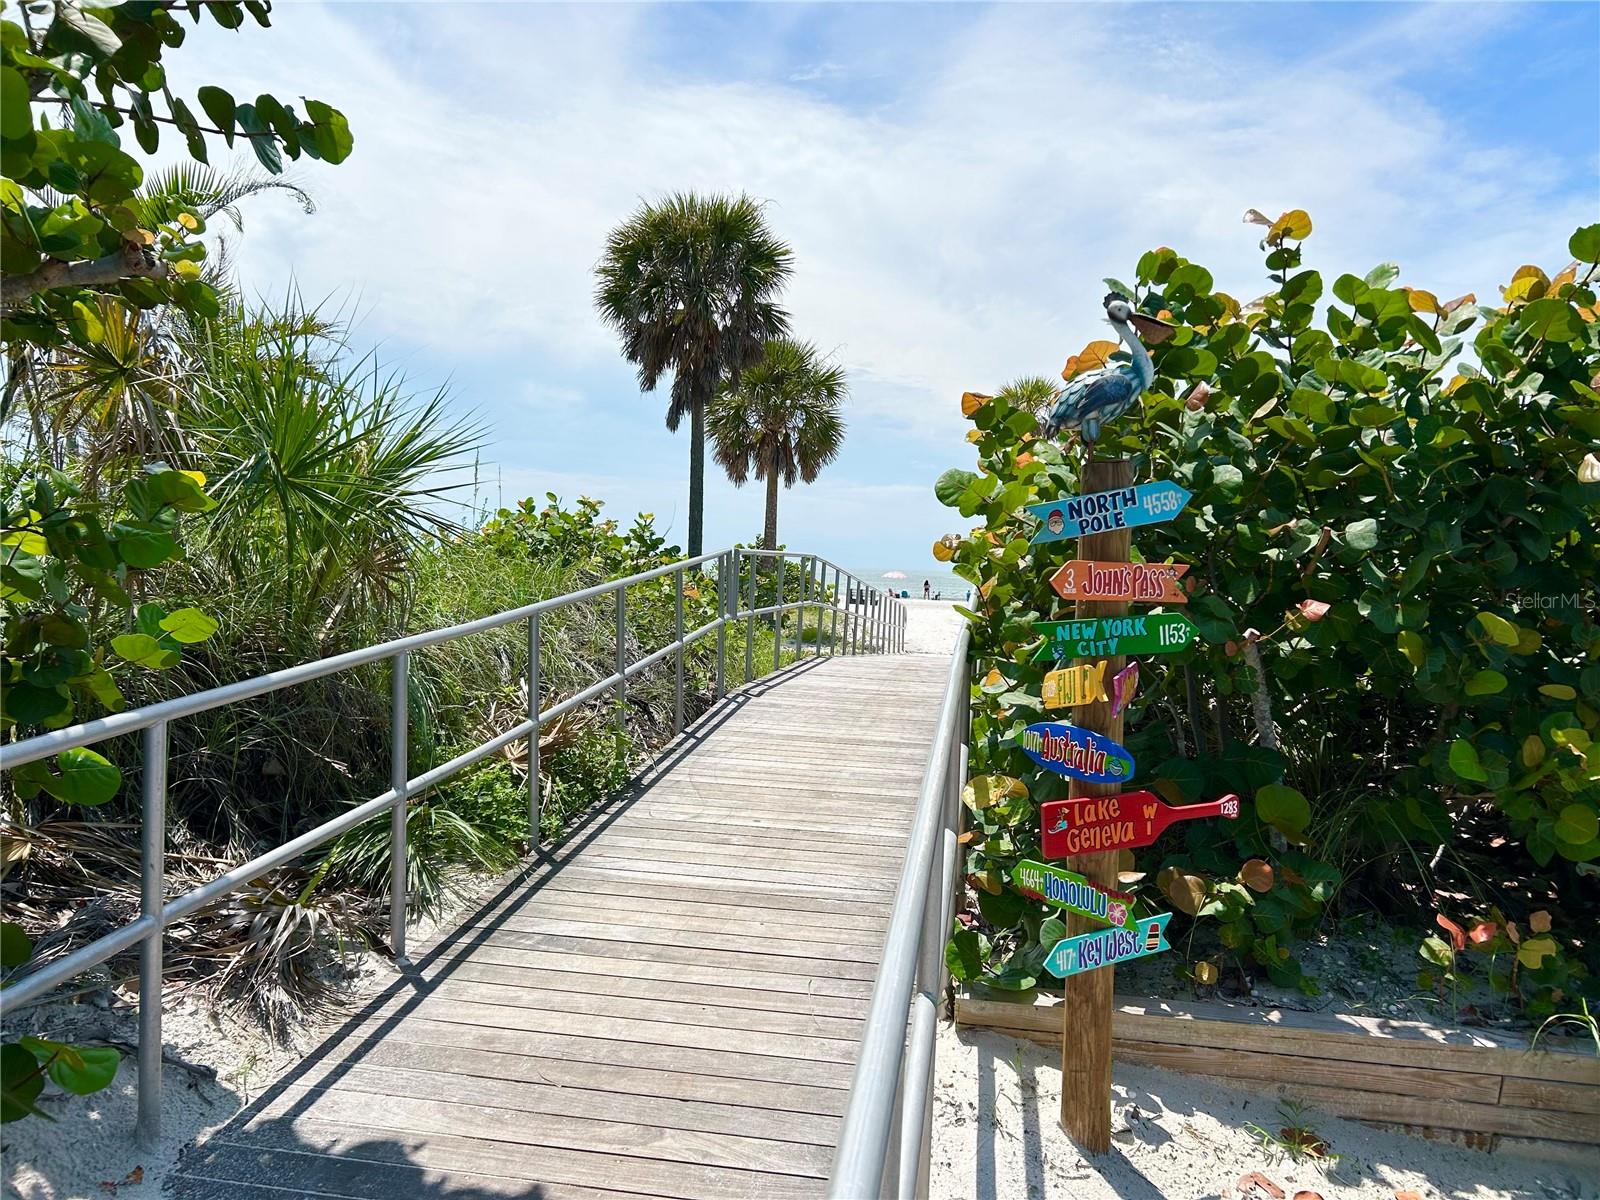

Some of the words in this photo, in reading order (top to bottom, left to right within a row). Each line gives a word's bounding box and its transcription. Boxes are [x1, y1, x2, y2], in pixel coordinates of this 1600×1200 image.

[1067, 487, 1138, 520] NORTH
[1143, 490, 1178, 516] 4558
[1078, 511, 1126, 535] POLE
[1065, 568, 1075, 589] 3
[1132, 564, 1166, 600] PASS
[1056, 623, 1098, 642] NEW
[1101, 617, 1148, 639] YORK
[1159, 623, 1186, 646] 1153
[1076, 637, 1119, 657] CITY
[1041, 728, 1108, 777] Australia
[1220, 800, 1238, 815] 1283
[1066, 820, 1135, 853] Geneva
[1019, 867, 1040, 891] 4664
[1043, 871, 1108, 919] HONOLULU
[1056, 948, 1073, 972] 417
[1078, 936, 1103, 969] Key
[1105, 930, 1143, 962] West
